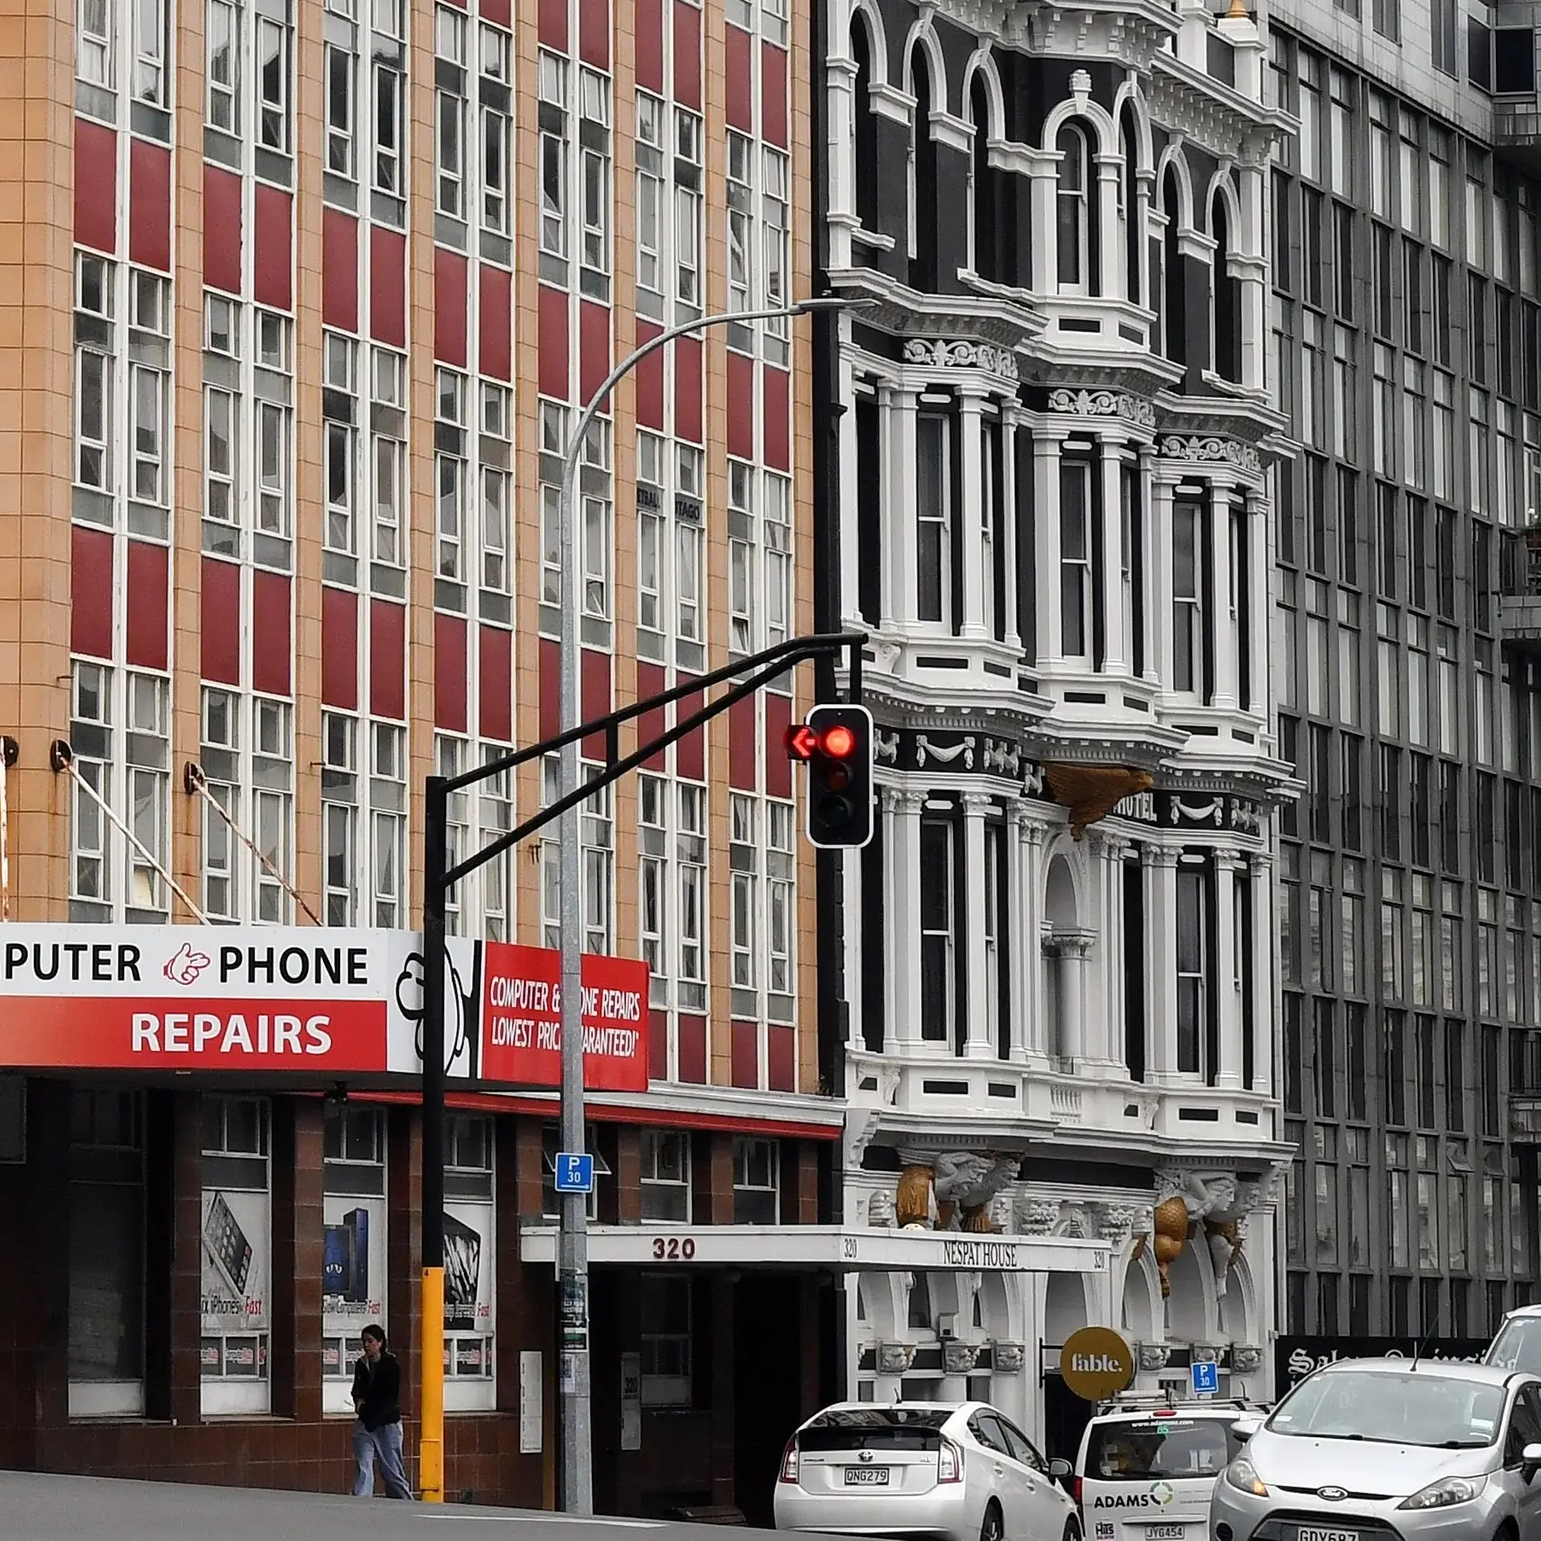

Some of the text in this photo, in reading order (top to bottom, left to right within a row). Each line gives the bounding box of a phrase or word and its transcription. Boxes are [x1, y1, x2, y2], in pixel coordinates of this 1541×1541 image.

[219, 946, 368, 985] PHONE
[491, 976, 549, 1011] COMPUTER
[580, 989, 599, 1017] ONE
[601, 989, 640, 1021] REPAIRS
[131, 1013, 332, 1054] REPAIRS
[492, 1016, 533, 1047] LOWEST
[536, 1021, 560, 1051] PRIC
[568, 1157, 580, 1170] P
[567, 1171, 581, 1183] 30
[653, 1238, 695, 1259] 320
[844, 1239, 857, 1258] 320
[943, 1242, 1017, 1268] NESPAT HOUSE
[1094, 1251, 1105, 1269] 320
[244, 1295, 262, 1315] Fast
[1199, 1365, 1208, 1376] P
[1200, 1377, 1210, 1386] 30
[846, 1471, 887, 1482] QNG279
[1094, 1494, 1149, 1509] ADAMS
[1146, 1527, 1183, 1539] JYG454
